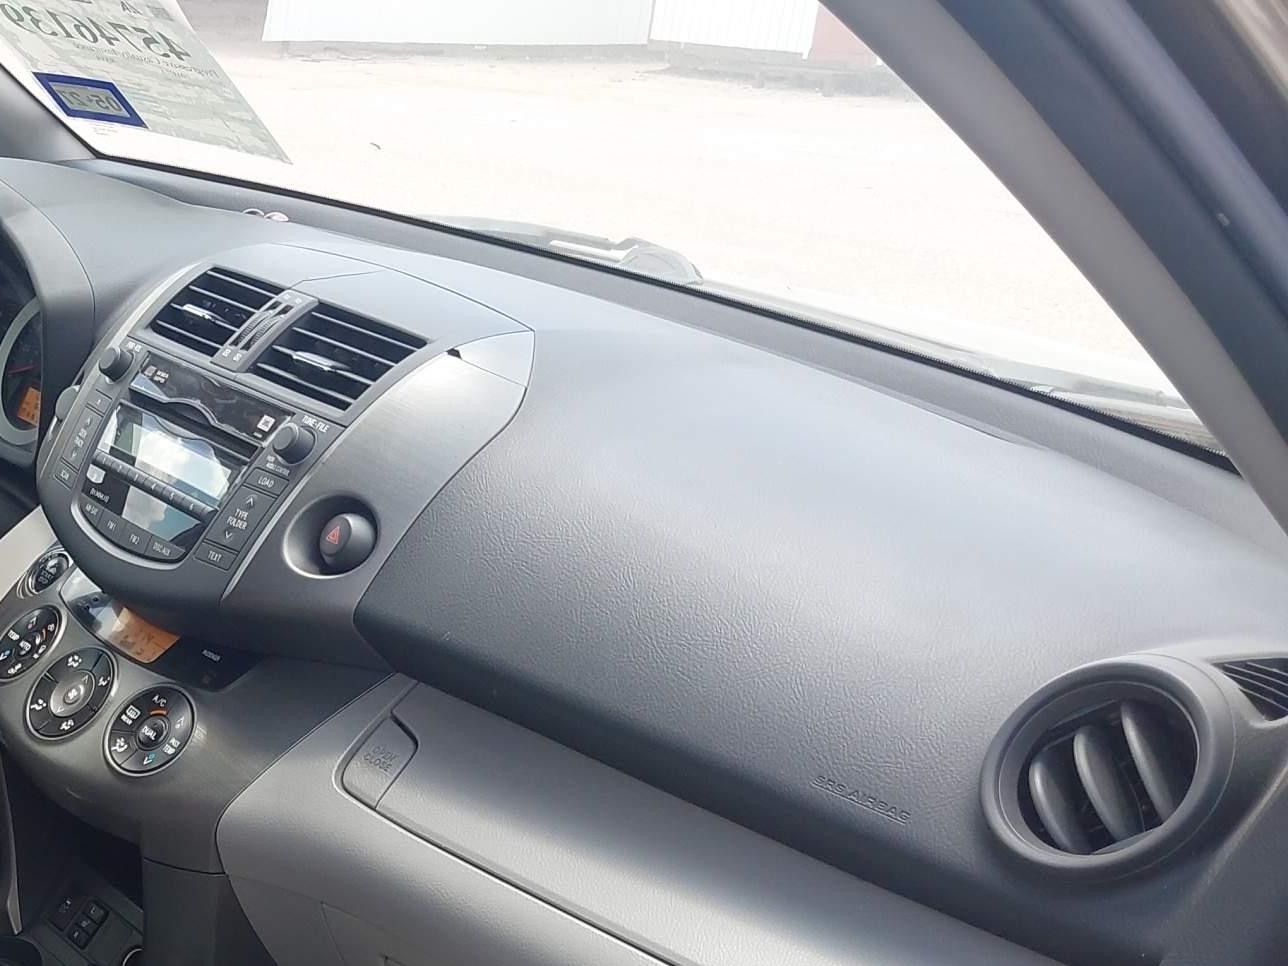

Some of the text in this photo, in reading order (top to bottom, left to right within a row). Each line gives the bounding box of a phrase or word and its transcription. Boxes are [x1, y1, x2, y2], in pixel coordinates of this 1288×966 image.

[258, 476, 274, 488] LOAD
[235, 508, 248, 520] TYPE
[227, 516, 247, 530] FOLDER
[208, 551, 222, 562] TEXT
[152, 695, 167, 707] A/C
[142, 725, 157, 740] DUAL
[813, 775, 912, 822] SRS AIRBAG
